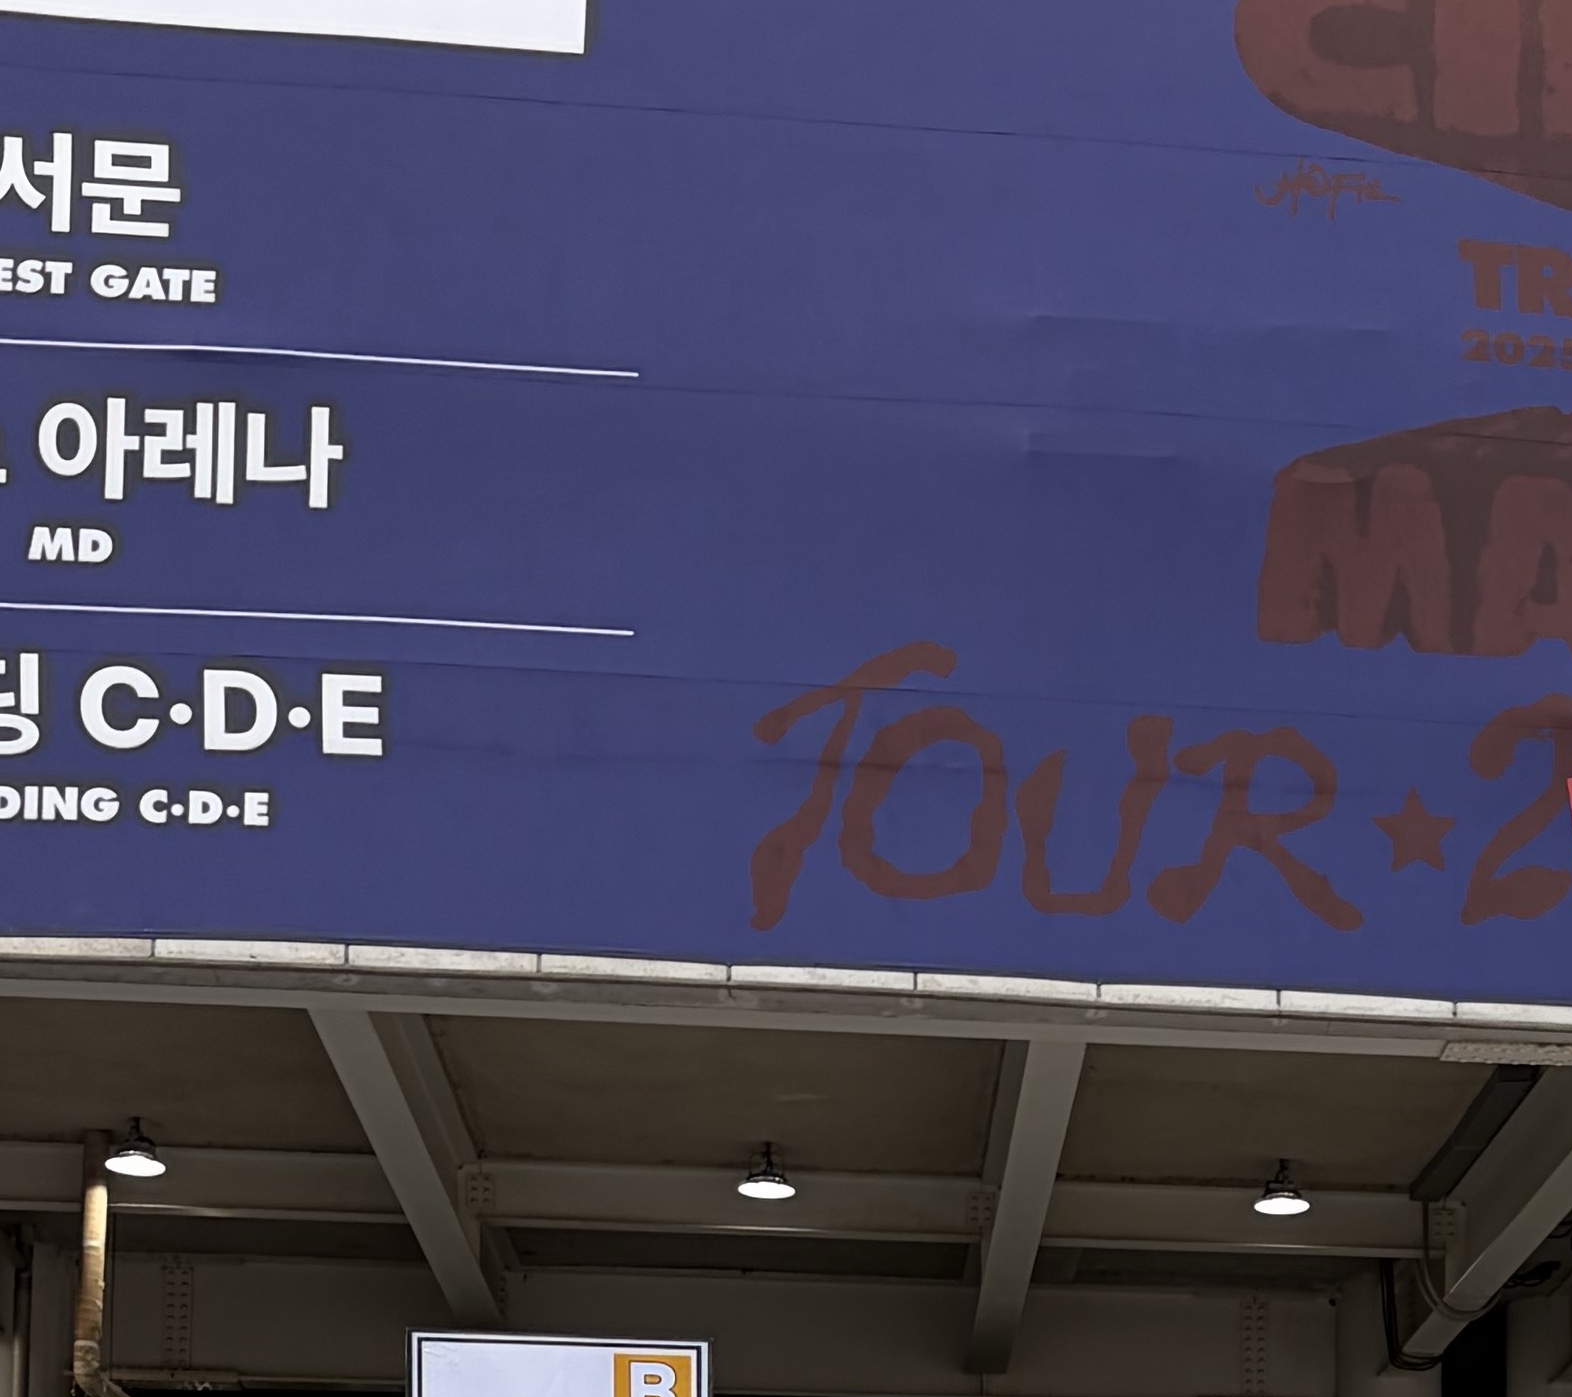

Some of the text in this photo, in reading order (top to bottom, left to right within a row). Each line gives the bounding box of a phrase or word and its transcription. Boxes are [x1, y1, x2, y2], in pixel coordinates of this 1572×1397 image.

[0, 132, 181, 238] 서문
[90, 264, 217, 303] GATE
[38, 397, 344, 509] 아레나
[28, 526, 113, 563] MD
[749, 640, 1366, 933] TOUR
